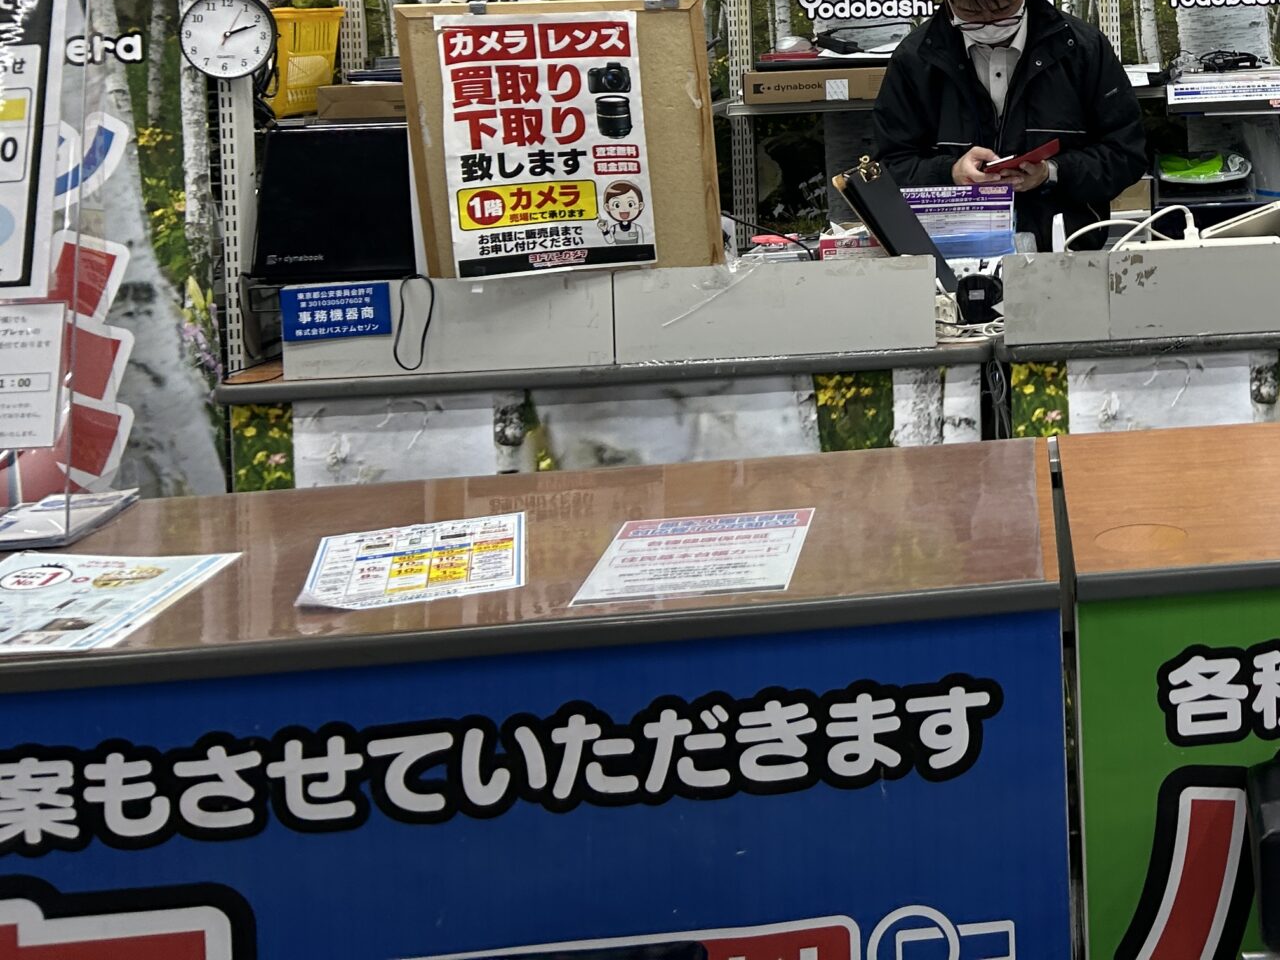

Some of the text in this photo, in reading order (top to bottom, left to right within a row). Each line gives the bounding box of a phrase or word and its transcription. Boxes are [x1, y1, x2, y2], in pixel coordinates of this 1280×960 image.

[206, 2, 216, 11] 11
[242, 4, 248, 12] 1
[192, 14, 204, 23] 10
[254, 14, 260, 22] 2
[185, 30, 192, 38] 9
[260, 32, 266, 40] 3
[549, 26, 625, 50] レンズ
[449, 29, 529, 58] カメラ
[65, 34, 142, 66] era
[190, 46, 198, 54] 8
[254, 46, 260, 54] 4
[204, 58, 210, 66] 7
[222, 62, 228, 71] 6
[240, 58, 248, 67] 5
[451, 64, 582, 108] 買取り
[774, 80, 824, 92] dynabook
[454, 106, 586, 150] 下取り
[460, 149, 587, 182] 致します
[510, 188, 581, 211] カメラ
[468, 194, 504, 219] 1階
[510, 210, 585, 222] 売場にて承ります
[478, 226, 582, 245] お気軽に販売員まで
[479, 237, 584, 256] お申し付けください
[298, 306, 374, 324] 事務機器商
[0, 686, 990, 844] 案もさせていただきます
